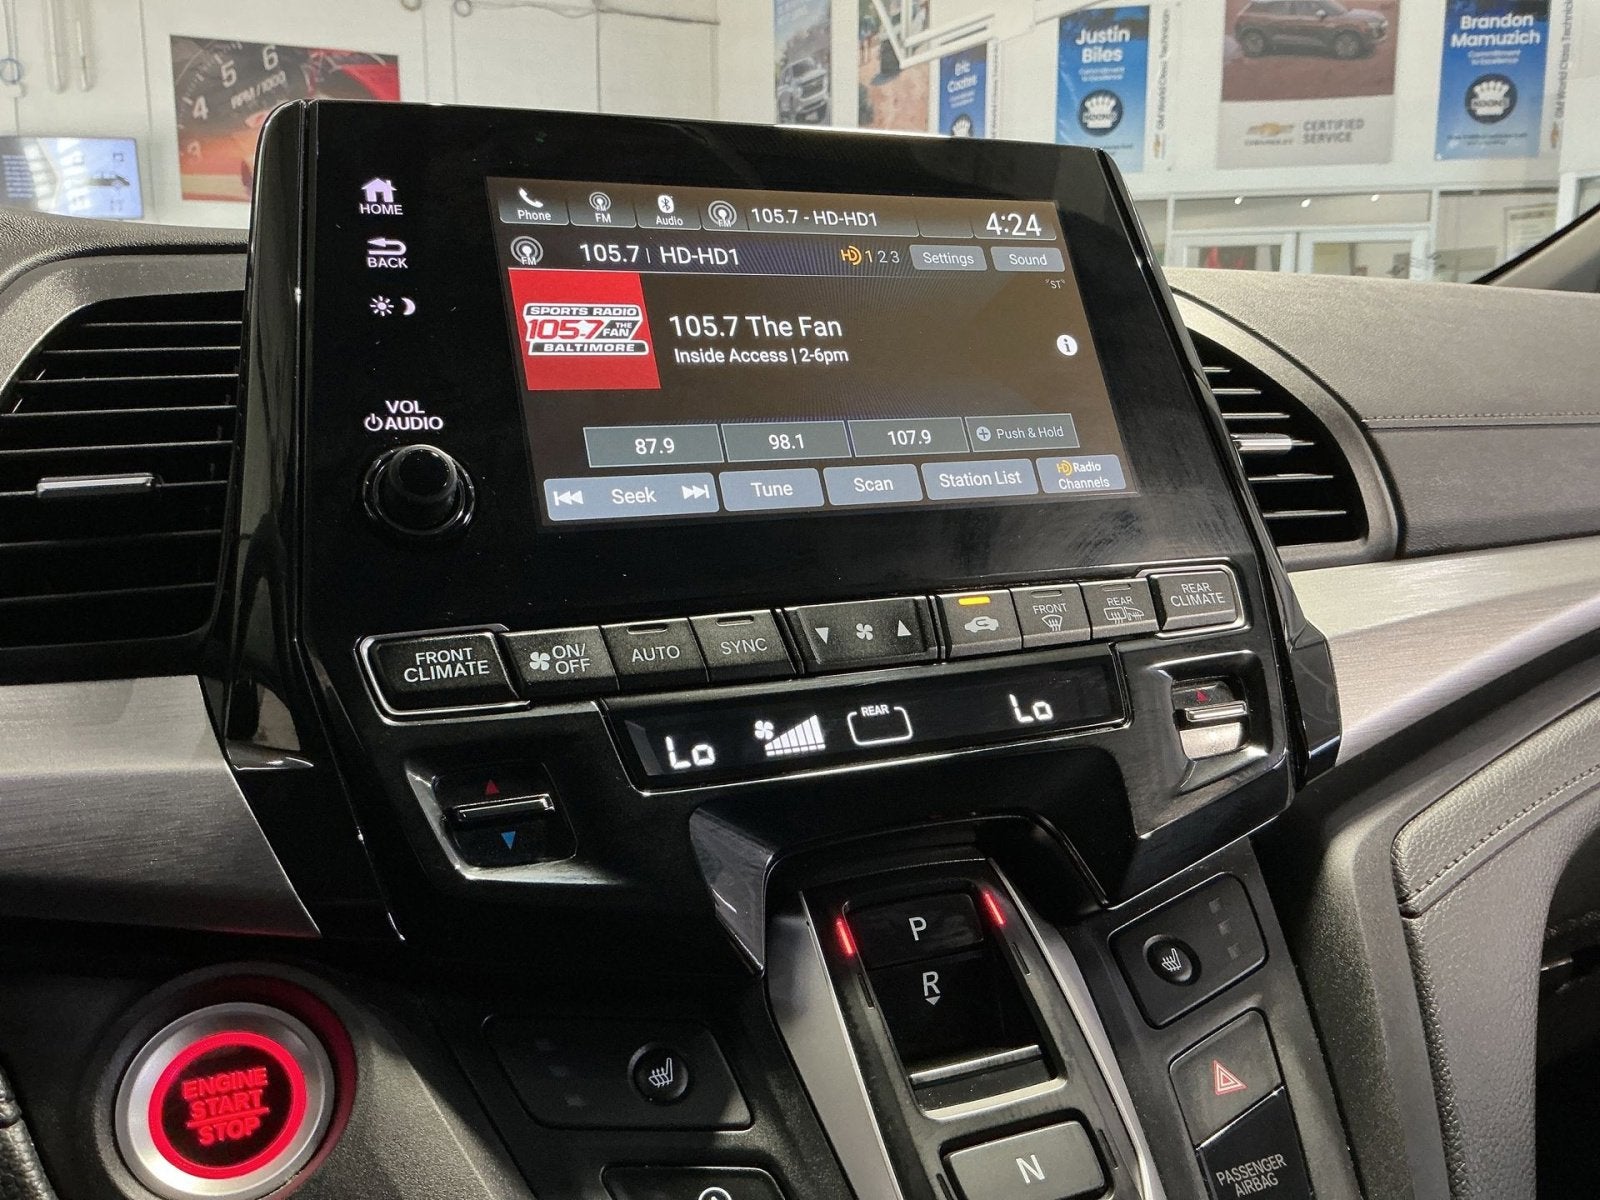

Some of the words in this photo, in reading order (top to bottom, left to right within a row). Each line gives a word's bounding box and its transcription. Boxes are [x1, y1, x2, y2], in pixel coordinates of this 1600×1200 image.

[1460, 12, 1534, 29] Brandon
[1075, 25, 1131, 45] Justin
[1450, 30, 1541, 47] Mamuzich
[262, 44, 279, 71] 6
[221, 60, 237, 88] 5
[192, 96, 208, 120] 4
[1303, 118, 1365, 131] CERTIFIED
[1303, 132, 1352, 144] SERVICE
[359, 203, 403, 215] HOME
[517, 209, 552, 221] Phone
[751, 207, 798, 225] 105.7
[813, 210, 878, 227] HD-HD1
[595, 213, 611, 224] FM
[655, 215, 684, 227] Audio
[985, 212, 1042, 236] 4:24
[579, 243, 640, 263] 105.7
[660, 245, 740, 265] HD-HD1
[879, 250, 888, 264] 2
[891, 250, 900, 264] 3
[922, 251, 975, 266] Settings
[1009, 253, 1048, 266] Sound
[367, 257, 409, 269] BACK
[530, 306, 588, 316] SPORTS
[593, 306, 637, 316] RADIO
[528, 319, 604, 340] 105.7
[602, 328, 630, 338] FAN
[669, 315, 739, 337] 105.7
[745, 316, 793, 337] The
[799, 316, 843, 337] Fan
[543, 342, 635, 352] BALTIMORE
[674, 348, 724, 364] Inside
[729, 350, 788, 364] Access
[801, 348, 850, 365] 2-6pm
[385, 400, 426, 414] VOL
[385, 416, 444, 431] AUDIO
[768, 433, 804, 450] 98.1
[887, 429, 932, 446] 107.9
[996, 427, 1026, 440] Push
[1028, 429, 1037, 438] &
[1038, 426, 1064, 438] Hold
[634, 437, 675, 455] 87.9
[1073, 461, 1102, 473] Radio
[853, 477, 894, 492] Scan
[939, 471, 993, 488] Station
[996, 470, 1022, 485] List
[1058, 476, 1110, 490] Channels
[611, 487, 657, 505] Seek
[751, 481, 794, 497] Tune
[1181, 582, 1213, 595] REAR
[1033, 601, 1068, 615] FRONT
[1106, 595, 1134, 608] REAR
[1170, 591, 1227, 608] CLIMATE
[552, 643, 586, 660] ON/
[631, 645, 681, 663] AUTO
[720, 637, 768, 655] SYNC
[415, 647, 473, 665] FRONT
[403, 659, 490, 683] CLIMATE
[555, 658, 591, 675] OFF
[860, 704, 890, 717] REAR
[1009, 693, 1054, 724] Lo
[664, 736, 716, 770] Lo
[909, 916, 928, 942] P
[922, 970, 941, 997] R
[183, 1067, 268, 1099] ENGINE
[191, 1089, 263, 1119] START
[199, 1117, 260, 1145] STOP
[1015, 1152, 1046, 1184] N
[1215, 1152, 1287, 1187] PASSENGER
[1235, 1172, 1280, 1198] AIRBAG
